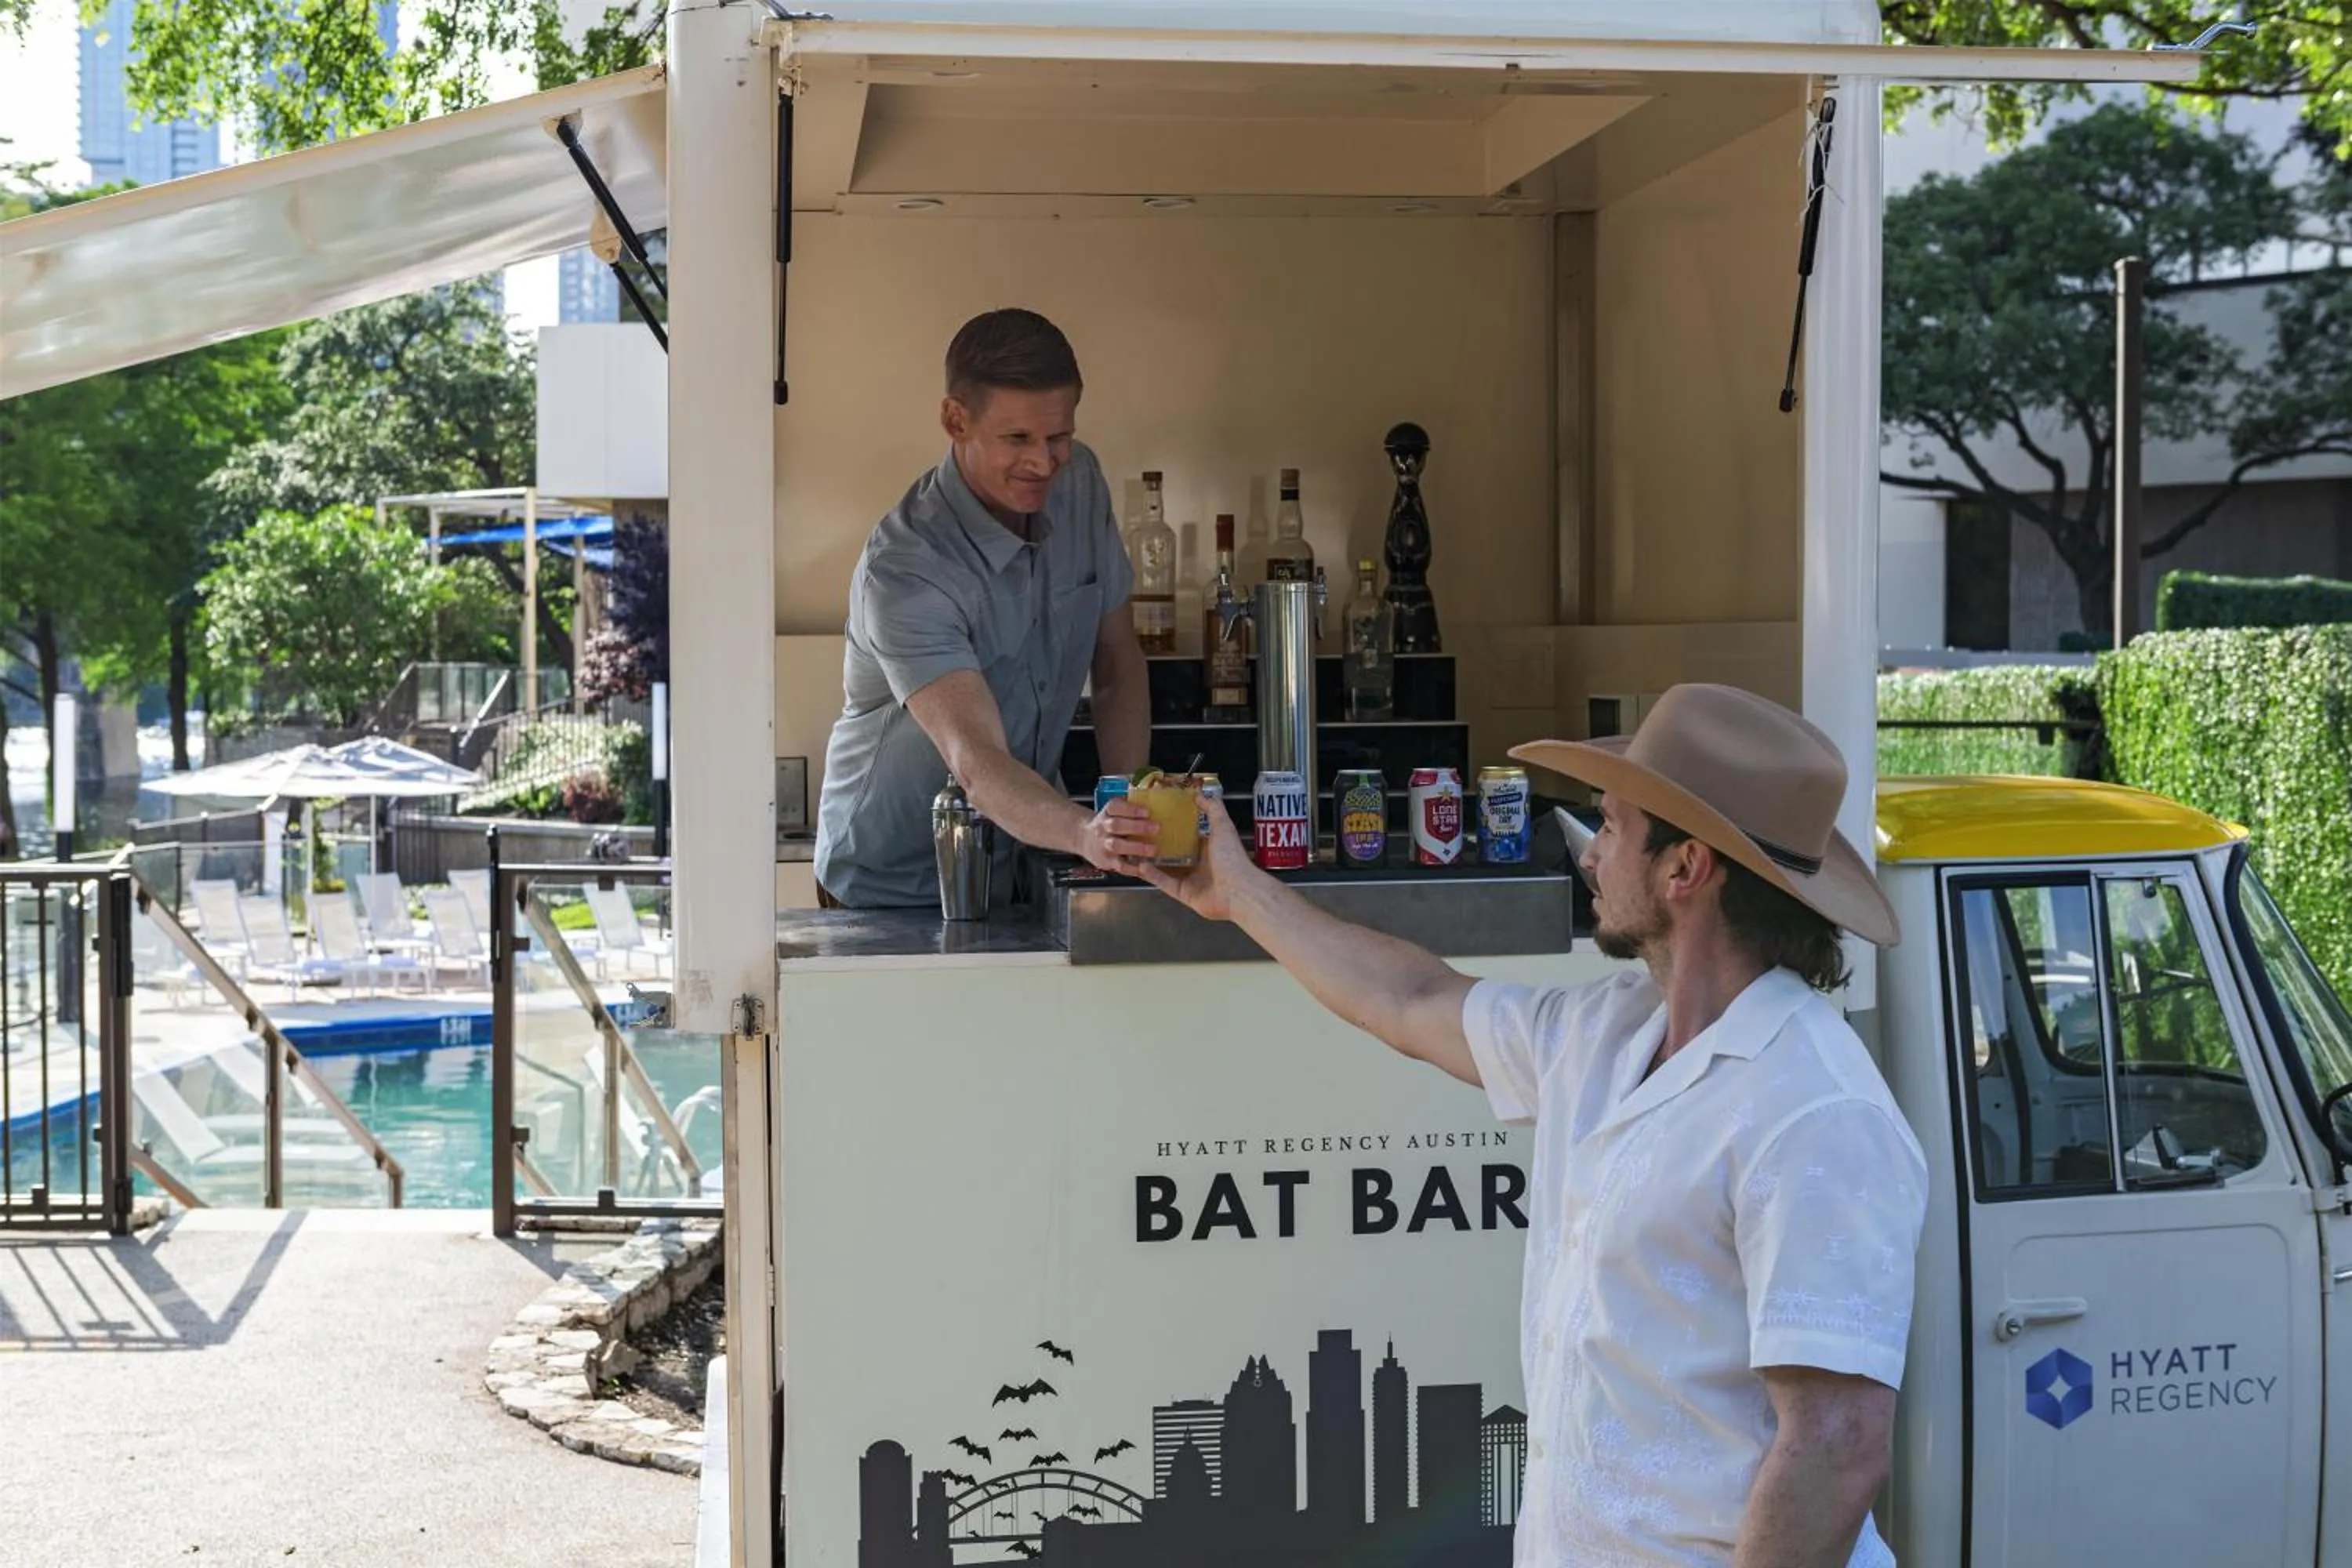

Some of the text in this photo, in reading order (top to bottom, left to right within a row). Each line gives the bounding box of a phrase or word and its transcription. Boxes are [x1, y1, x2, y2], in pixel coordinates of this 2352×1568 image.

[1257, 794, 1307, 817] NATIVE
[1156, 1131, 1508, 1156] HYATT REGENCY AUSTIN
[1136, 1163, 1529, 1242] BAT BAR
[2111, 1344, 2237, 1378] HYATT
[2111, 1377, 2278, 1414] REGENCY
